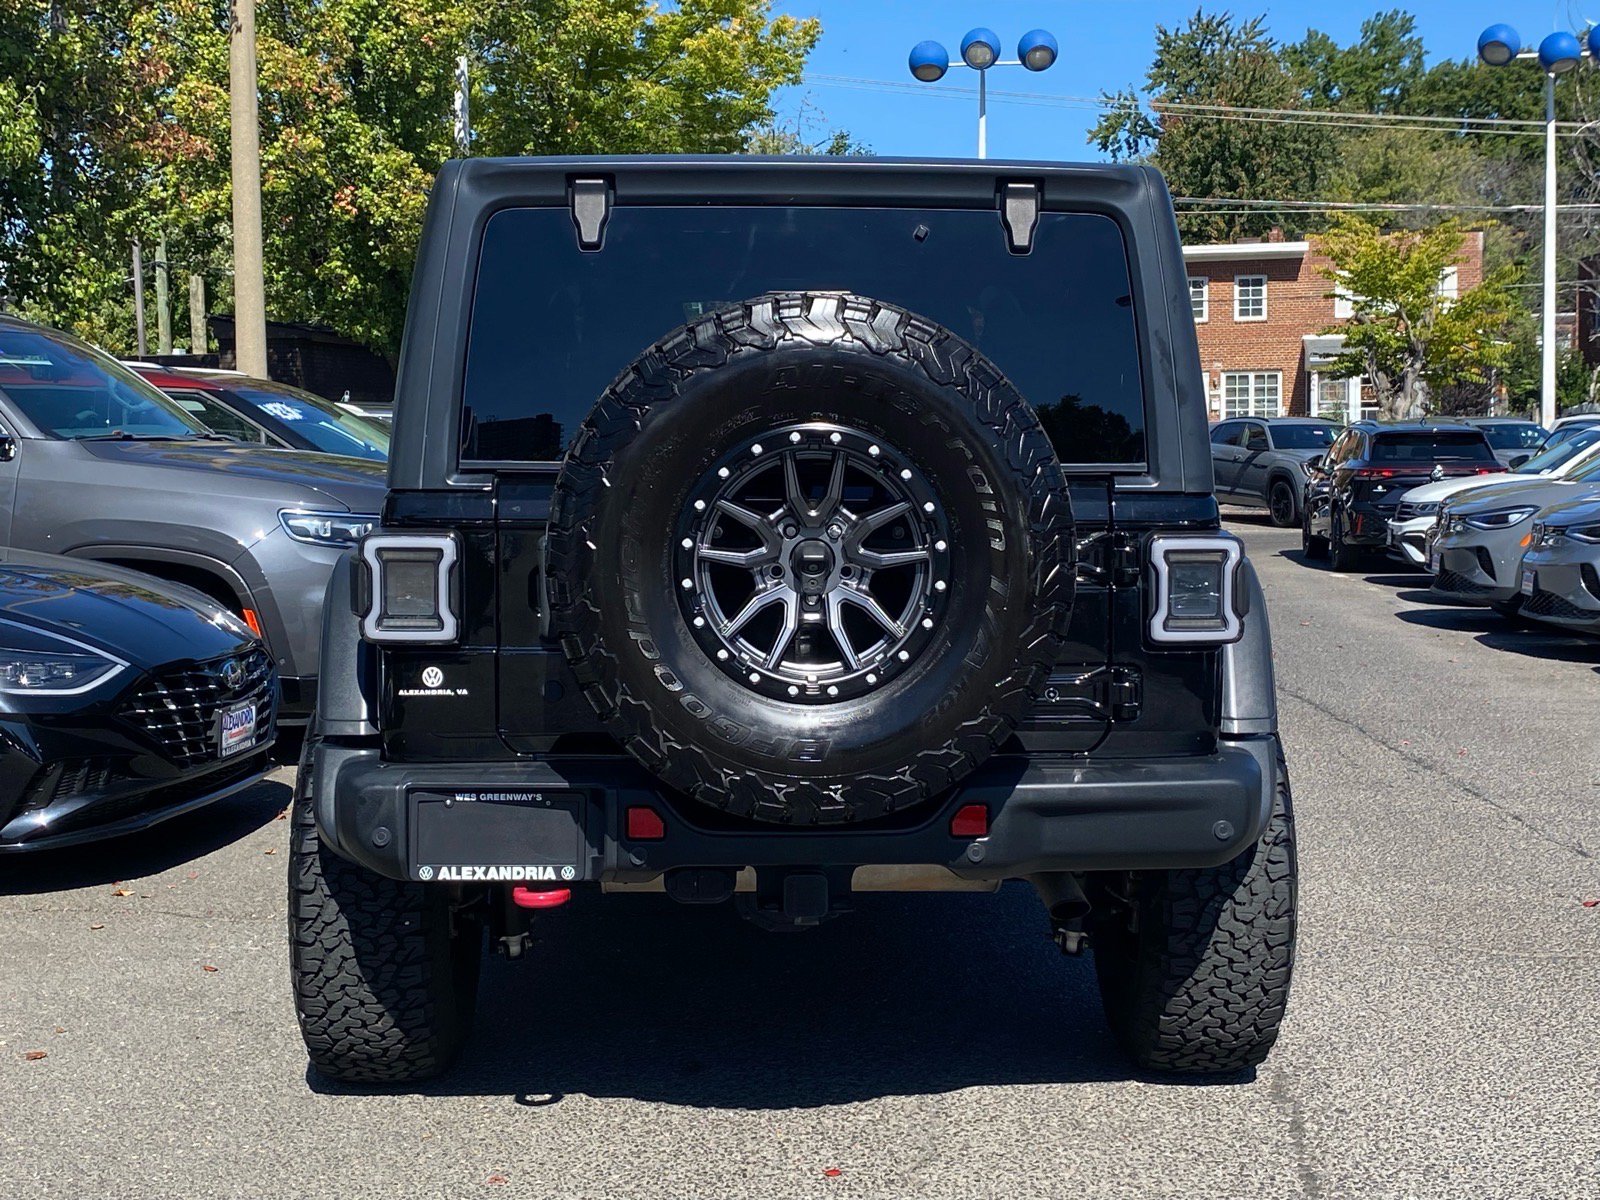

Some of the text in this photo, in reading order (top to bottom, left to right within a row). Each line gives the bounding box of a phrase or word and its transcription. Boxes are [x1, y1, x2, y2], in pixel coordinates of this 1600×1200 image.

[455, 793, 542, 801] WES GREENWAY'S
[437, 866, 556, 880] ALEXANDRIA
